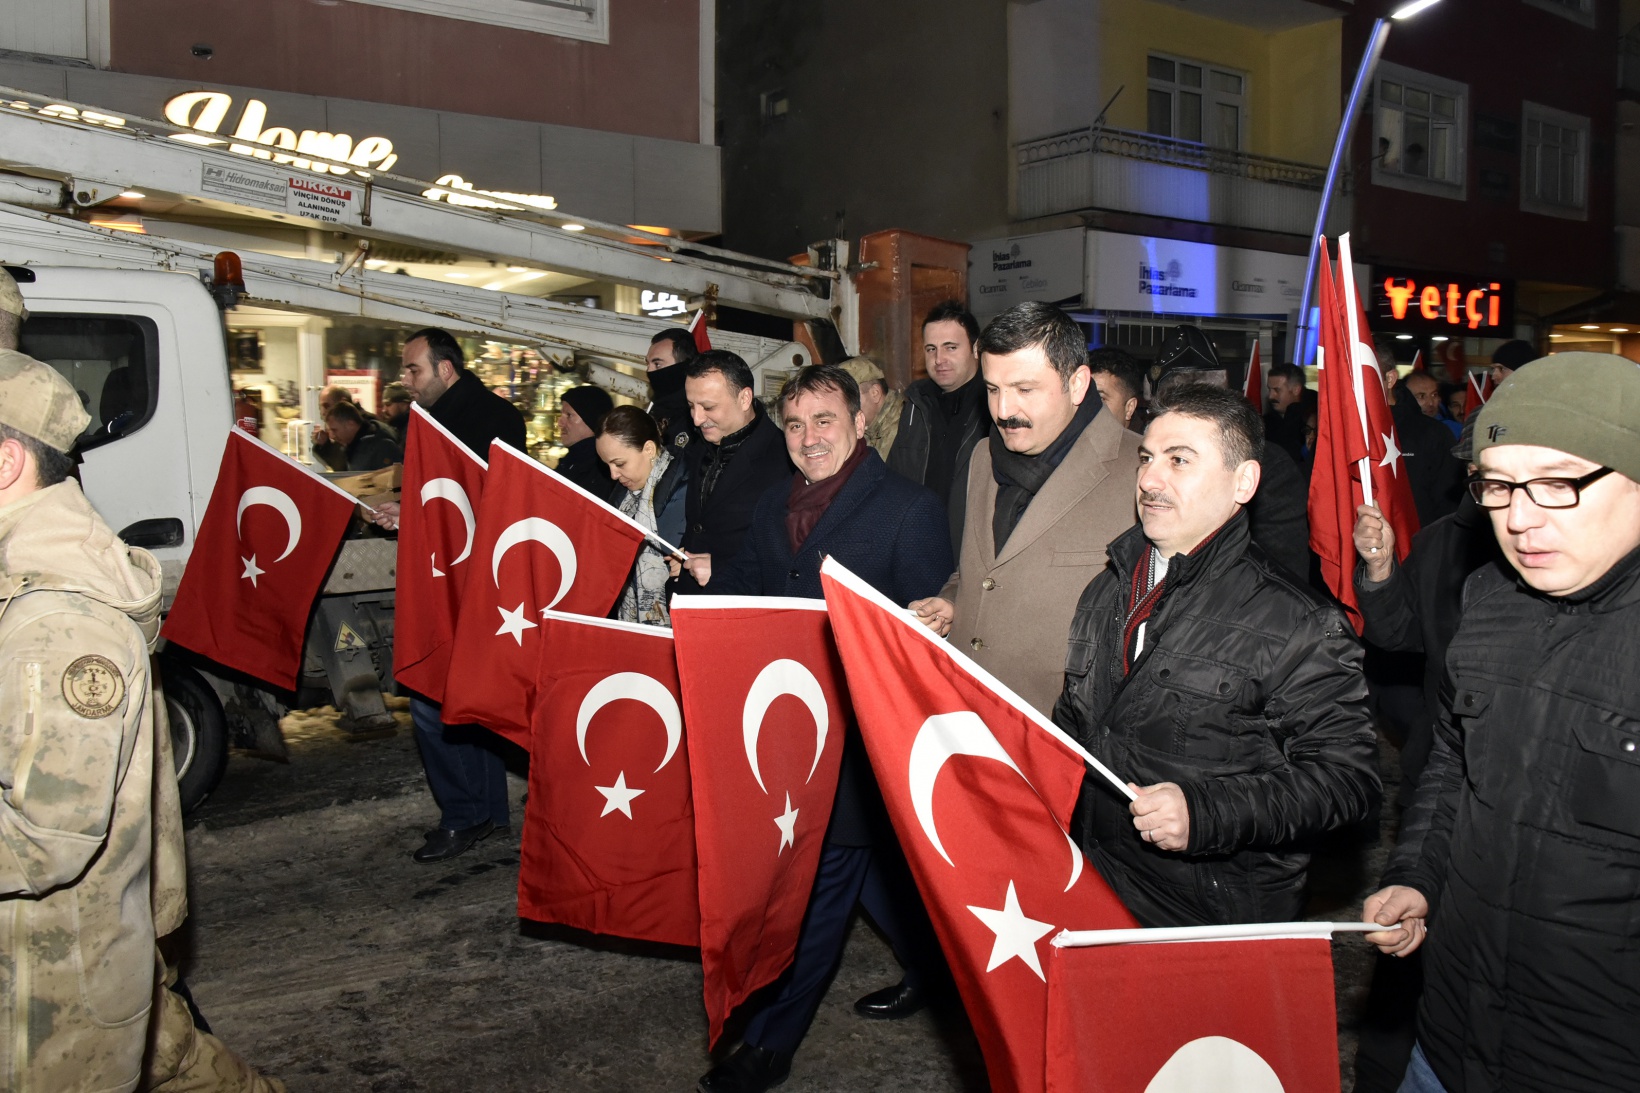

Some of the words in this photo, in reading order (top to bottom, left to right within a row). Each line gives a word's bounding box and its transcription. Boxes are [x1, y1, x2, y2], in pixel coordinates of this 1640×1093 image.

[224, 171, 286, 194] Hidromaksan
[293, 190, 319, 201] VİNÇİN
[320, 196, 346, 208] DÖNÜŞ
[298, 201, 340, 215] ALANINDAN
[993, 260, 1032, 272] Pazarlama
[1139, 280, 1197, 298] Pazarlama
[72, 702, 114, 717] JANDARMA
